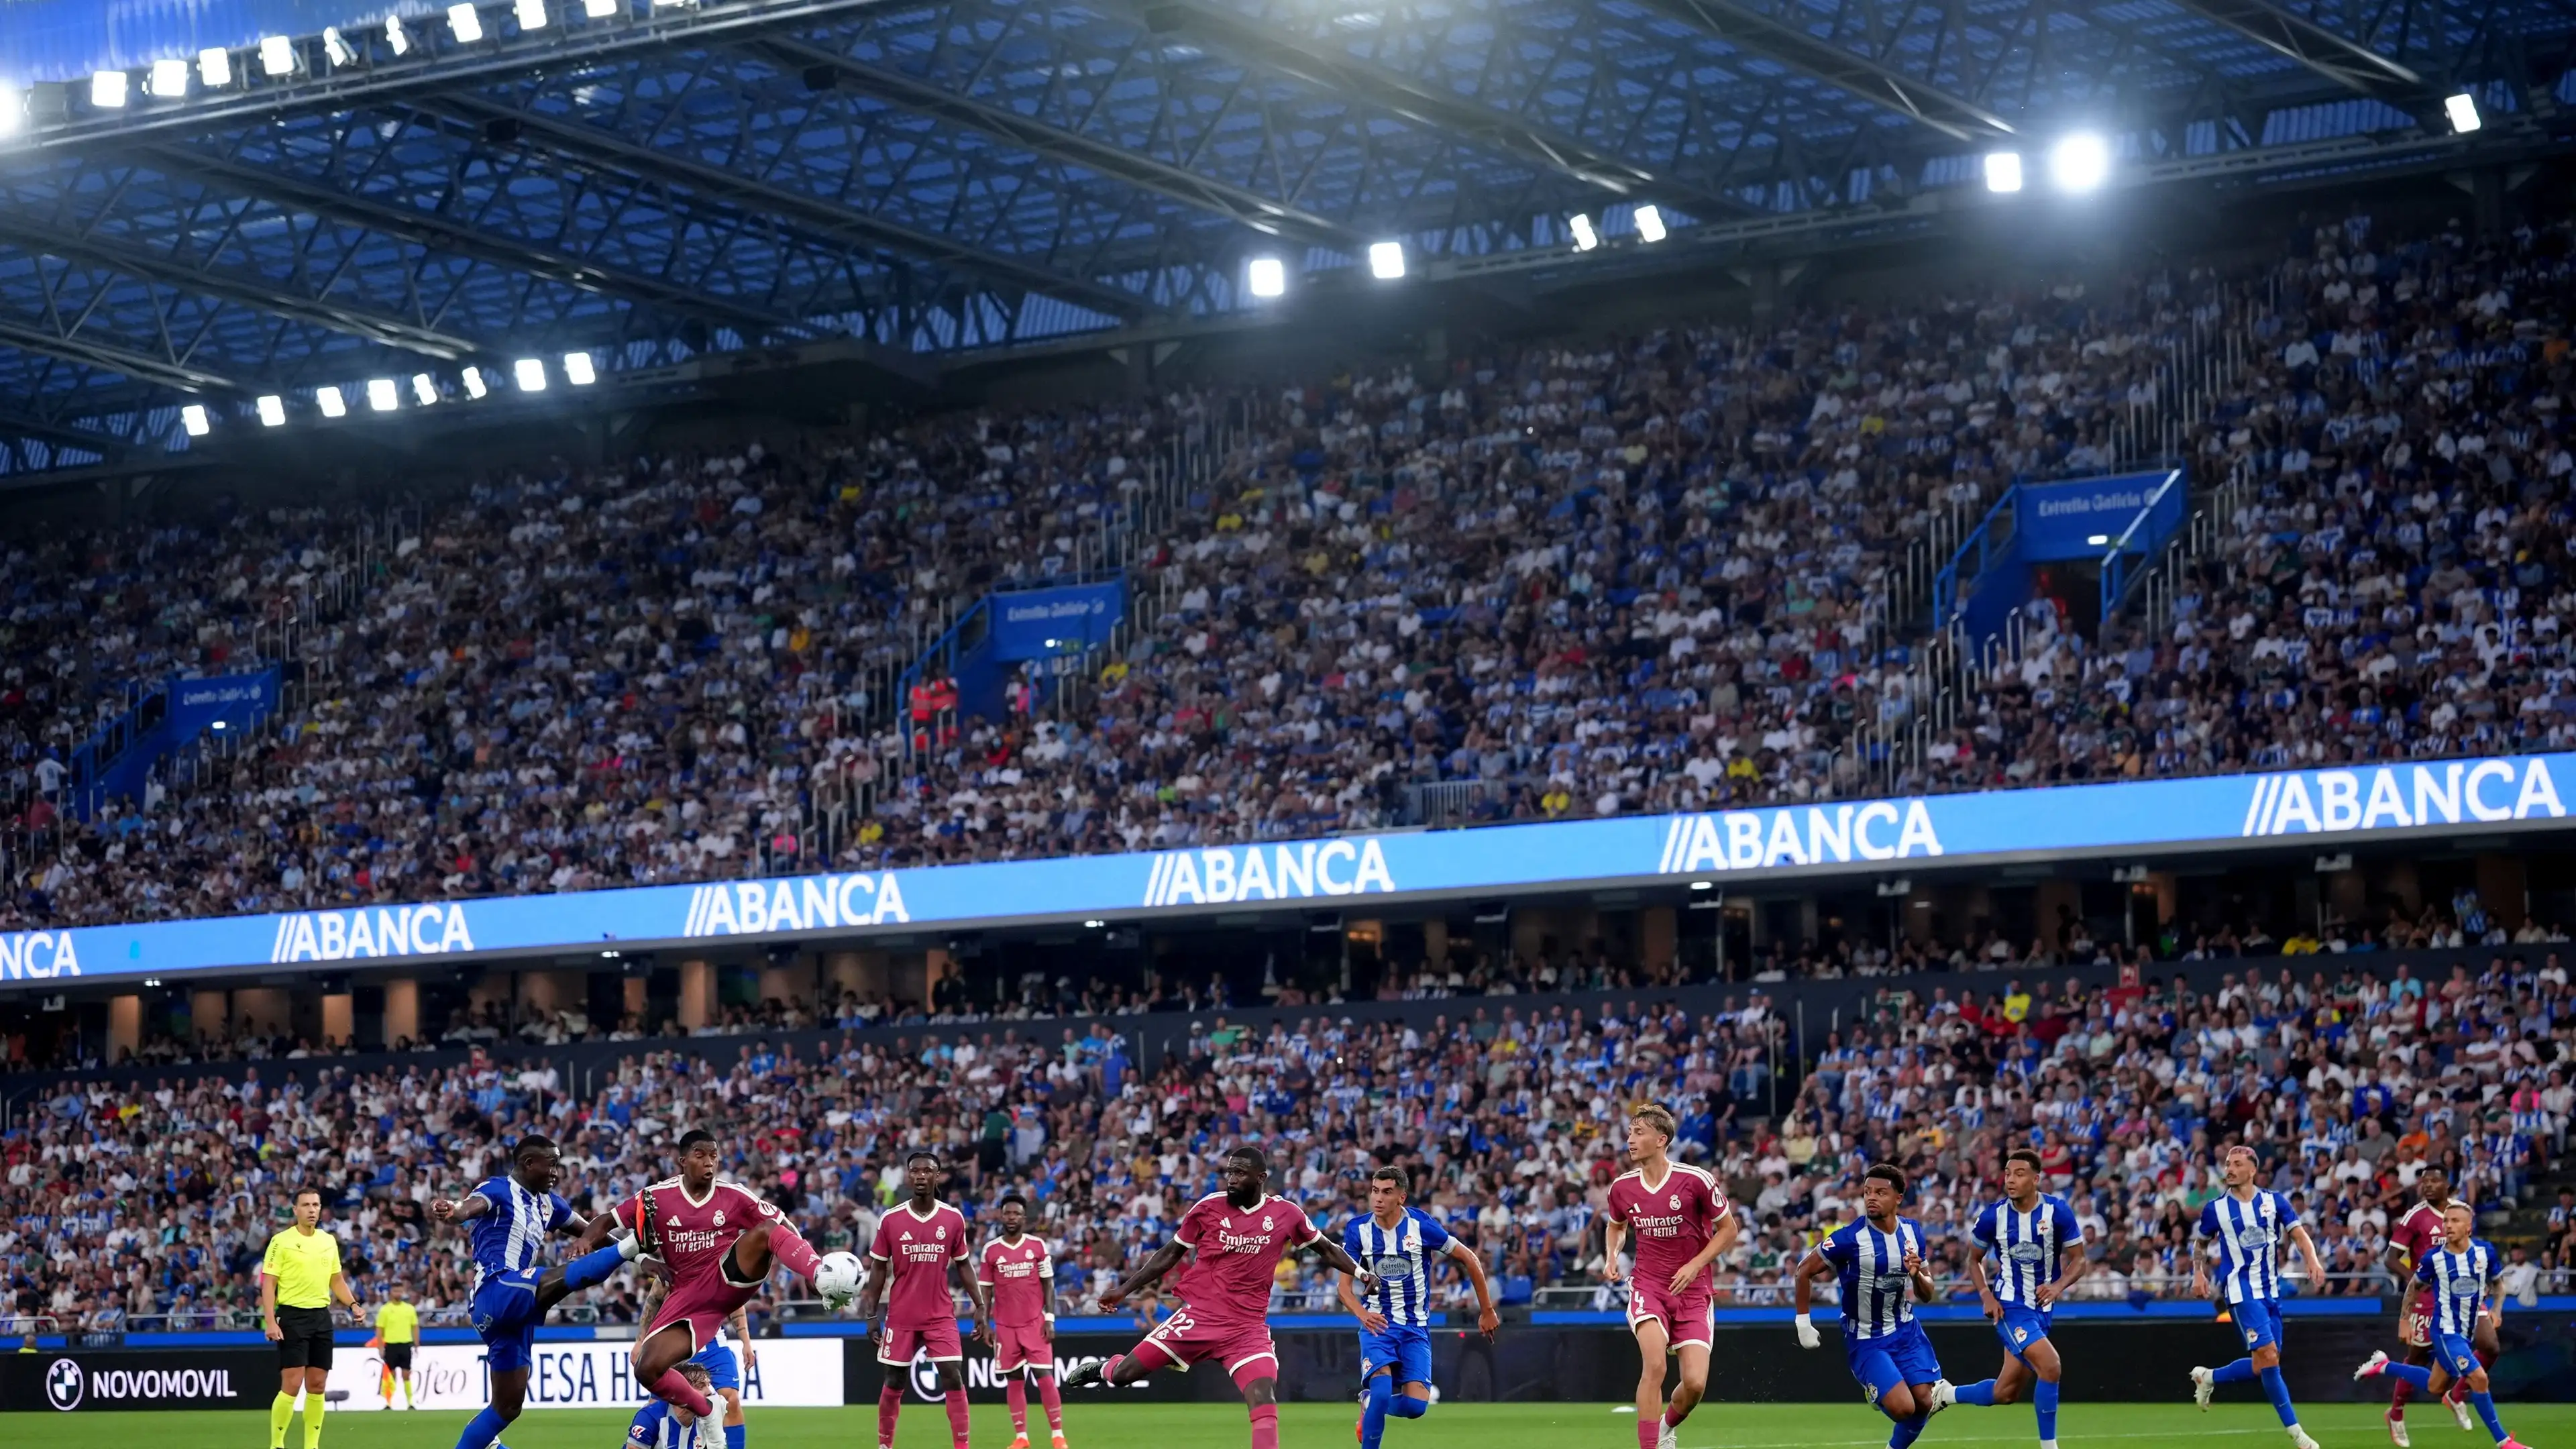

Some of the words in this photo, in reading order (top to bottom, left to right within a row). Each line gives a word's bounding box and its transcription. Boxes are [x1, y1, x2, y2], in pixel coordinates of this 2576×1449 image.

[1632, 1214, 1683, 1228] Emirates
[1653, 1226, 1678, 1237] BETTER
[675, 1242, 686, 1252] FLY
[902, 1242, 945, 1255] Emirates
[918, 1252, 938, 1263] BETTER
[1635, 1291, 1644, 1308] 4
[1167, 1312, 1195, 1338] 22
[93, 1369, 237, 1399] NOVOMOVIL
[477, 1352, 598, 1403] TESA
